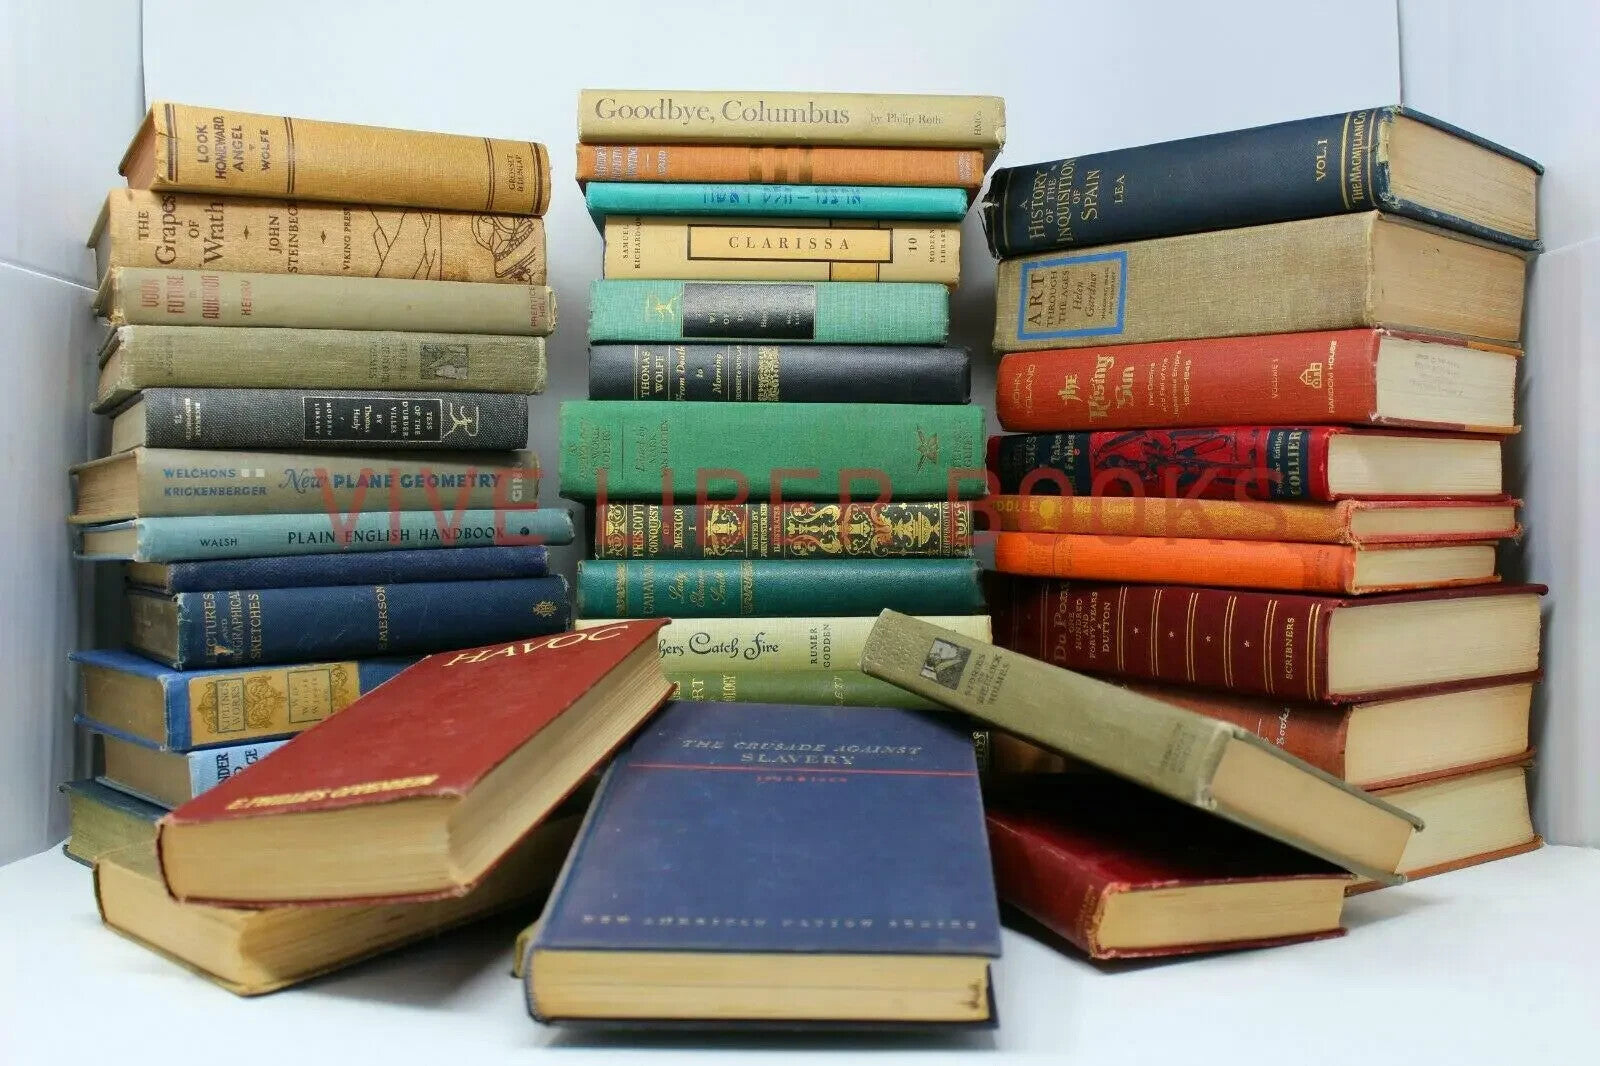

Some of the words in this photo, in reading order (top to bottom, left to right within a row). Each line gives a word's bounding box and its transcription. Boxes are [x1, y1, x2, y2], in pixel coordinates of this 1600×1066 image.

[595, 98, 716, 125] Goodbye,
[721, 99, 850, 125] Columbus
[870, 113, 883, 123] by
[887, 112, 915, 126] Philip
[918, 114, 941, 124] Roth
[196, 124, 209, 164] LOOK
[231, 125, 244, 173] ANGEL
[260, 128, 271, 172] WOLFE
[1019, 199, 1028, 210] A
[1046, 178, 1057, 202] THE
[1056, 158, 1076, 243] INQUISITION
[1072, 189, 1081, 204] OF
[1080, 169, 1100, 220] SPAIN
[1114, 174, 1125, 204] LEA
[1028, 171, 1047, 239] HISTORY
[1045, 208, 1054, 224] OF
[138, 210, 149, 240] THE
[155, 194, 183, 264] Grapes
[189, 219, 200, 239] OF
[203, 201, 224, 264] Wrath
[268, 215, 282, 254] JOHN
[287, 201, 299, 273] STEINBEC
[343, 235, 352, 270] VIKING
[729, 237, 849, 250] CLARISSA
[908, 237, 918, 253] 10
[241, 280, 252, 316] HENRY
[1046, 270, 1058, 328] THROUGH
[1060, 270, 1070, 298] AGES
[1072, 281, 1083, 310] Helen
[1084, 271, 1097, 318] Gardner
[1028, 274, 1045, 326] ART
[1058, 301, 1067, 325] THE
[676, 345, 687, 374] Death
[1328, 340, 1337, 370] HOUSE
[641, 350, 651, 398] THOMAS
[695, 368, 704, 378] to
[712, 353, 724, 394] Morning
[1089, 353, 1115, 422] Rising
[1115, 366, 1135, 409] Sun
[676, 377, 687, 401] From
[1057, 373, 1083, 406] The
[1327, 373, 1335, 414] RANDOM
[352, 408, 361, 430] Hardy
[376, 414, 383, 425] BY
[415, 405, 421, 416] OF
[1272, 431, 1284, 459] Edition
[163, 468, 236, 479] WELCHONS
[278, 467, 322, 491] New
[333, 474, 394, 488] PLANE
[399, 474, 500, 488] GEOMETRY
[1288, 431, 1302, 496] COLLIER
[164, 485, 267, 496] KRICKENBERGER
[200, 537, 239, 548] WALSH
[288, 531, 336, 545] PLAIN
[344, 529, 411, 543] ENGLISH
[419, 527, 504, 541] HANDBOOK
[649, 504, 661, 554] CONQUEST
[663, 523, 670, 535] OF
[674, 508, 684, 549] MEXICO
[1090, 591, 1098, 622] YEARS
[248, 593, 262, 660] SKETCHES
[1075, 598, 1083, 650] HUNDRED
[1102, 601, 1111, 653] DUTTON
[441, 625, 629, 667] HAVOC
[689, 632, 739, 659] Catch
[810, 627, 818, 665] RUMER
[823, 623, 831, 668] GODDEN
[1053, 633, 1067, 662] Du
[1285, 617, 1295, 680] SCRIBNERS
[680, 738, 725, 750] THE
[734, 741, 825, 753] CRUSADE
[834, 743, 923, 755] AGAINST
[740, 753, 857, 765] SLAVERY
